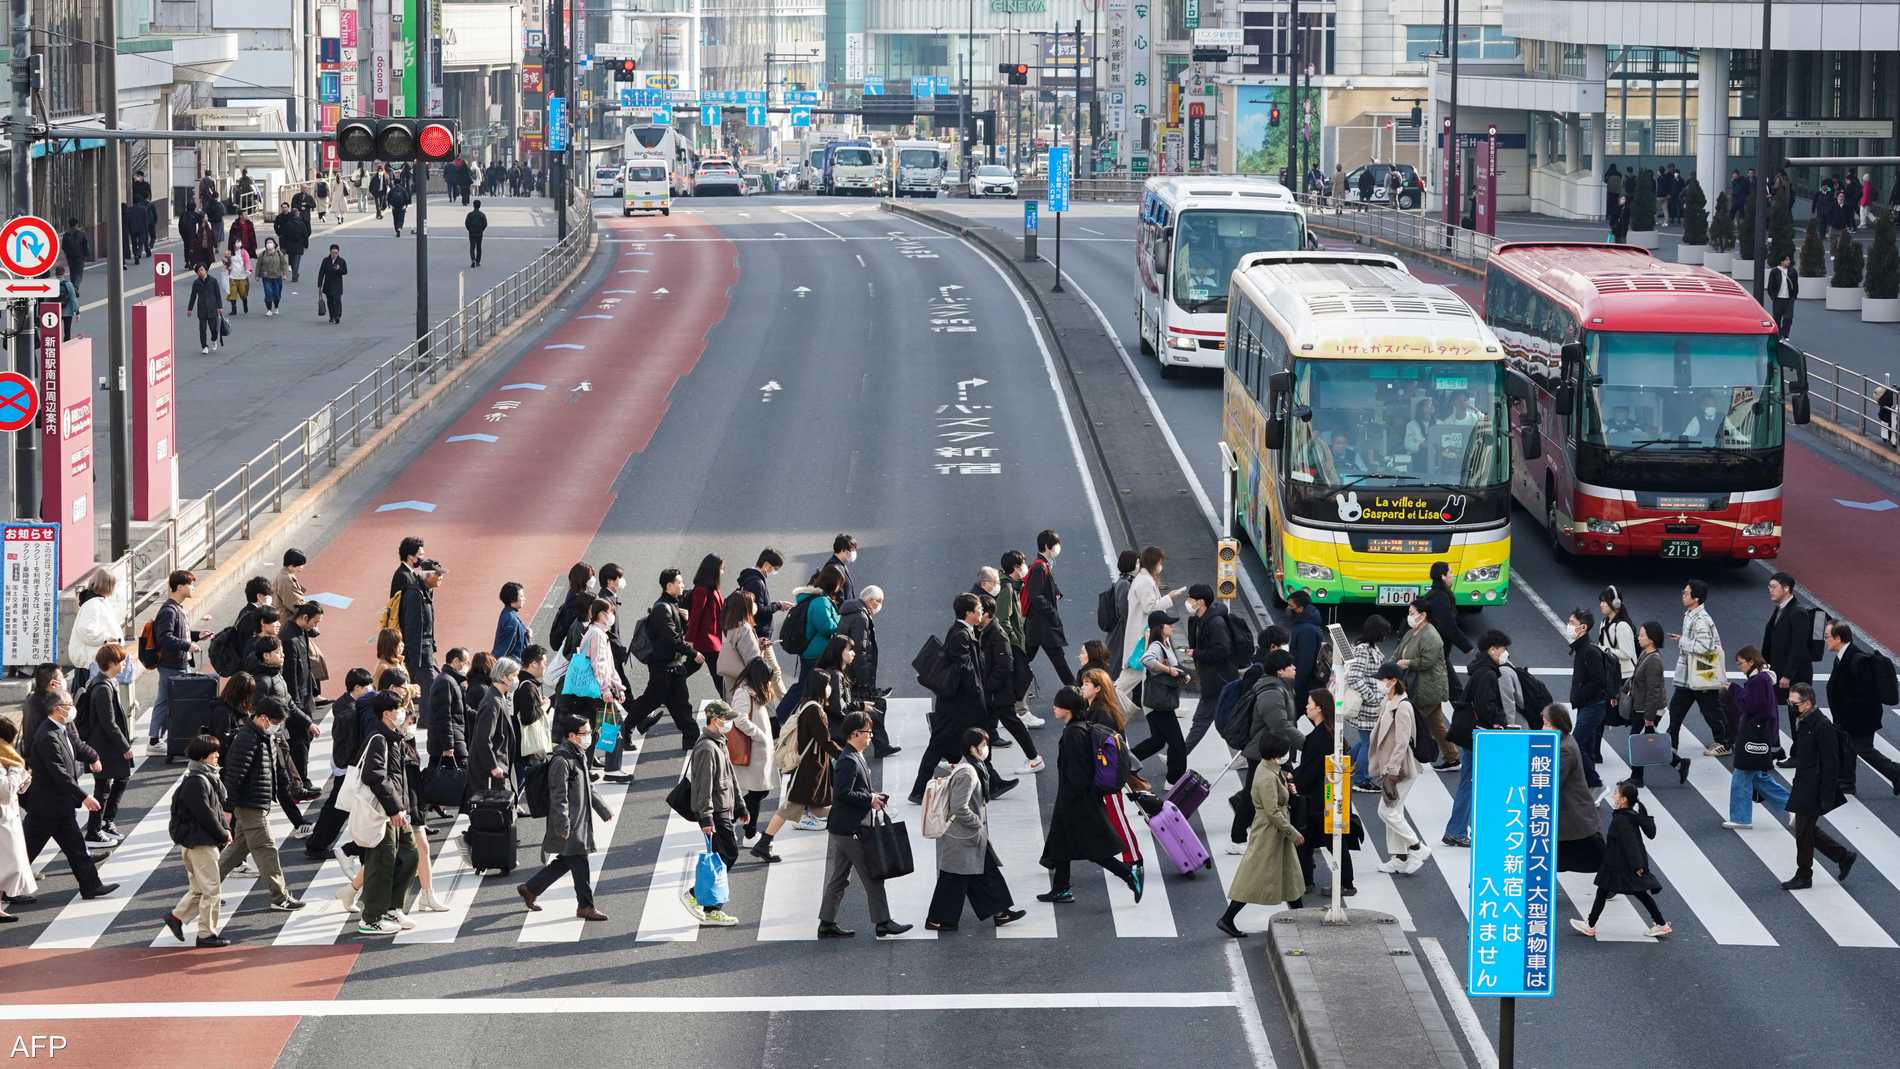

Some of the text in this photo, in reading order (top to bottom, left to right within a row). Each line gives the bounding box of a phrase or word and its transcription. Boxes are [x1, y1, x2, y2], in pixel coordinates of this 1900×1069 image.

[376, 55, 384, 94] docomo
[44, 336, 57, 435] 新宿駅南口周辺案内
[5, 529, 54, 540] お知らせ
[1362, 507, 1440, 522] Gaspard et Lisa
[1375, 496, 1427, 508] La ville de
[1502, 785, 1525, 943] バスタ新宿へは
[1526, 744, 1552, 988] 一般車・貸切バス・大型貨物車は
[1478, 877, 1500, 988] 入れません
